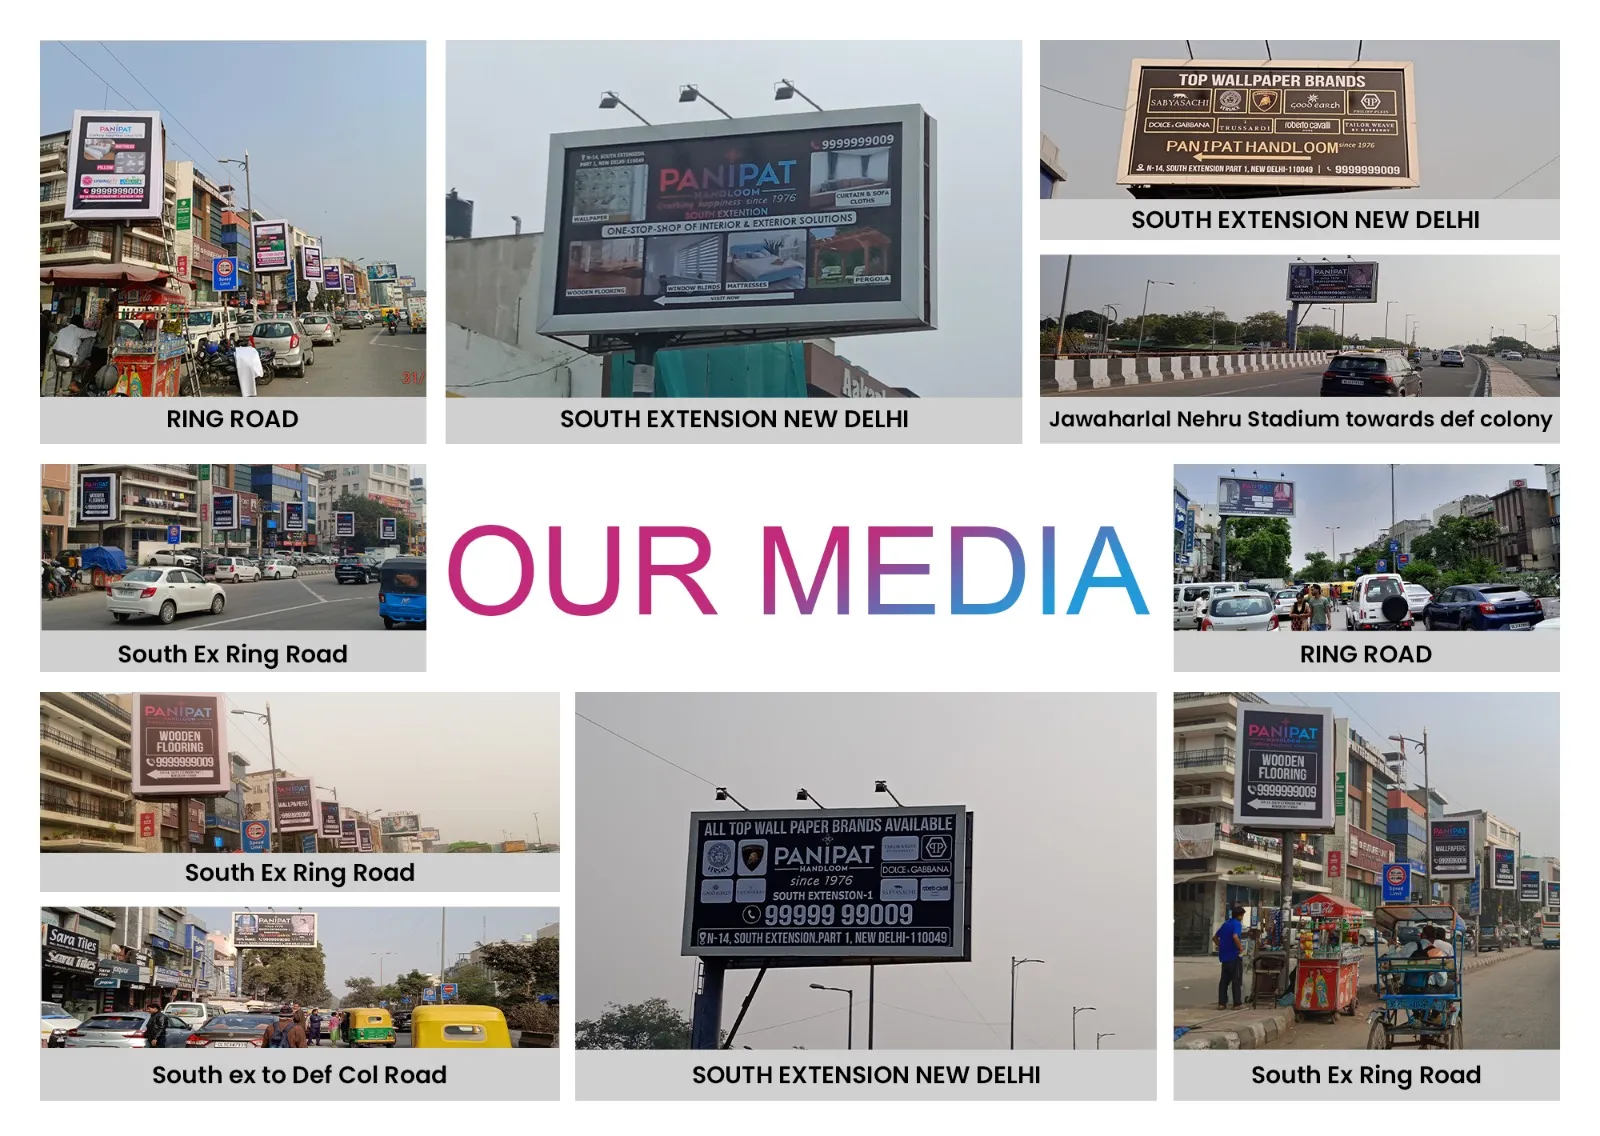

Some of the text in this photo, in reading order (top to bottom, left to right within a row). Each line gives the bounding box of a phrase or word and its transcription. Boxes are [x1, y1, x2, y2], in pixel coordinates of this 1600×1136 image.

[1179, 74, 1366, 88] TOP WALLPAPER BRANDS
[1151, 99, 1210, 107] SABYASACHI
[1285, 121, 1309, 129] roberto
[822, 134, 894, 150] 9999999009
[1246, 141, 1339, 154] HANDLOOM
[659, 160, 797, 192] PANIPAT
[1266, 166, 1314, 174] DELHI-110049
[1336, 166, 1400, 175] 9999999009
[694, 189, 760, 199] HANDLOOM
[836, 192, 865, 200] CURTAIN
[698, 196, 742, 209] happiness
[772, 194, 797, 204] 1976
[574, 215, 608, 223] WALLPAPER
[685, 208, 768, 220] SOUTH EXTENTION
[608, 213, 853, 236] ONE-STOP-SHOP OF INTERIOR & EXTERIOR SOLUTIONS
[855, 276, 890, 284] PERGOLA
[145, 706, 212, 718] PANIPAT
[159, 730, 201, 741] WOODEN
[1249, 725, 1318, 740] PANIPAT
[157, 742, 204, 753] FLOORING
[156, 757, 214, 767] 9999999009
[1262, 754, 1305, 768] WOODEN
[1259, 767, 1307, 781] FLOORING
[1258, 784, 1317, 798] 9999999009
[704, 817, 953, 836] ALL TOP WALL PAPER BRANDS AVAILABLE
[774, 845, 875, 866] PANIPAT
[883, 866, 906, 874] DOLCE
[910, 866, 950, 874] GABBANA
[790, 875, 854, 886] since 1976
[773, 891, 874, 901] SOUTH EXTENSION-1
[765, 904, 913, 926] 99999 99009
[49, 929, 76, 947] Sara
[77, 936, 97, 952] Tiles
[707, 932, 732, 946] N-14,
[734, 933, 763, 944] SOUTH
[855, 932, 876, 944] NEW
[878, 932, 948, 944] DELHI-110049
[49, 950, 97, 971] Sara Tiles
